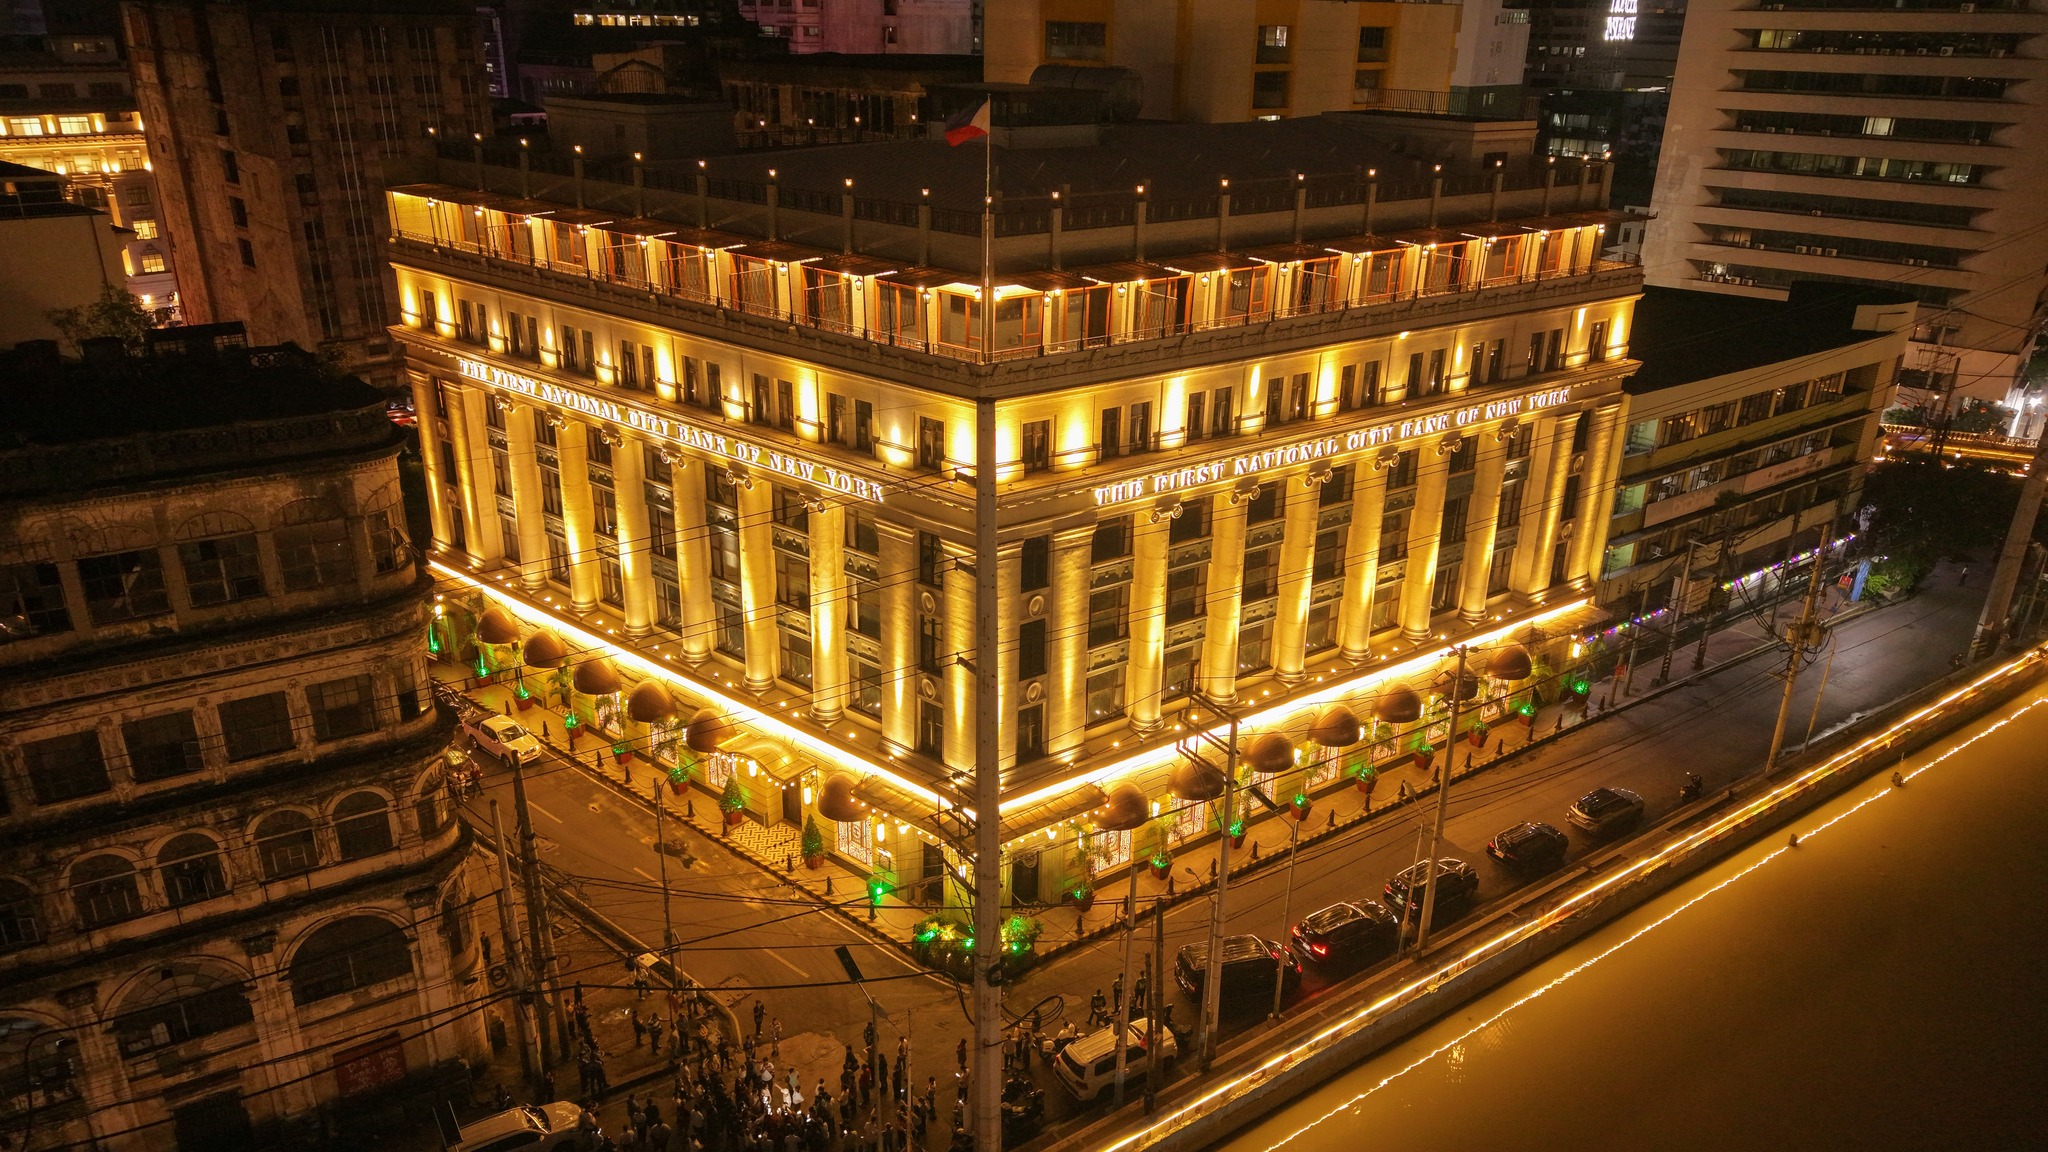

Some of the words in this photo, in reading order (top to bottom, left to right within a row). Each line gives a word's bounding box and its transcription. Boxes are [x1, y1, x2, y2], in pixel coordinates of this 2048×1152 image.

[459, 359, 487, 380] THE
[491, 369, 536, 396] FIRST
[540, 384, 621, 422] NATIONAL
[628, 409, 670, 436] CITY
[676, 424, 728, 456] BANK
[735, 442, 760, 464] OF
[769, 453, 815, 481] NEW
[824, 469, 885, 502] YORK
[1094, 479, 1144, 506] THE
[1153, 462, 1225, 493] FIRST
[1233, 438, 1339, 476] NATIONAL
[1346, 425, 1394, 450] CITY
[1399, 413, 1449, 439] BANK
[1456, 406, 1480, 426] OF
[1485, 399, 1522, 420] NEW
[1529, 388, 1572, 411] YORK
